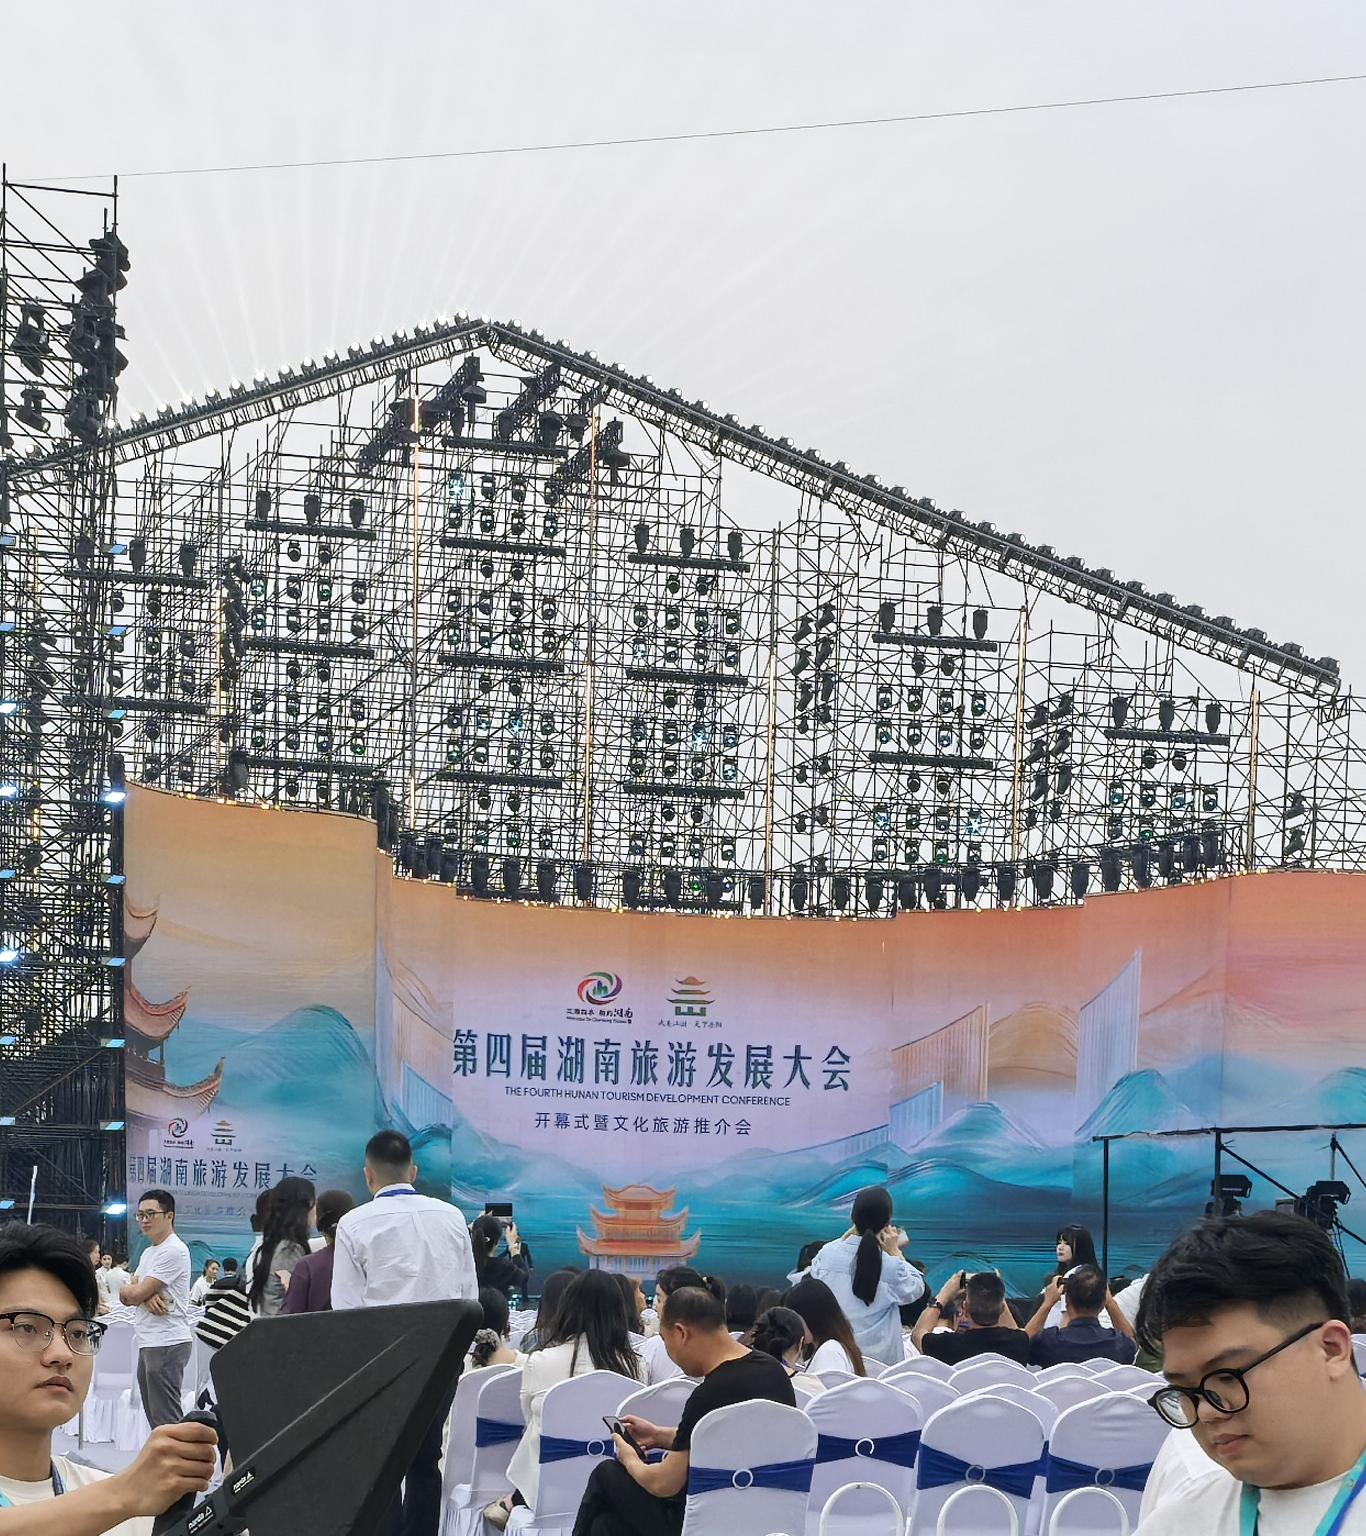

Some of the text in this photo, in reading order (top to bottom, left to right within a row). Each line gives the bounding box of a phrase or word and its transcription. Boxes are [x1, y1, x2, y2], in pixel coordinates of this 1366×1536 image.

[453, 1028, 851, 1092] 第四届湖南旅游发展大会
[505, 1086, 790, 1106] THE FOURTH HUNAN TOURISM DEVELOPMENT CONFERENCE
[535, 1112, 751, 1136] 开幕式暨文化旅游推介会
